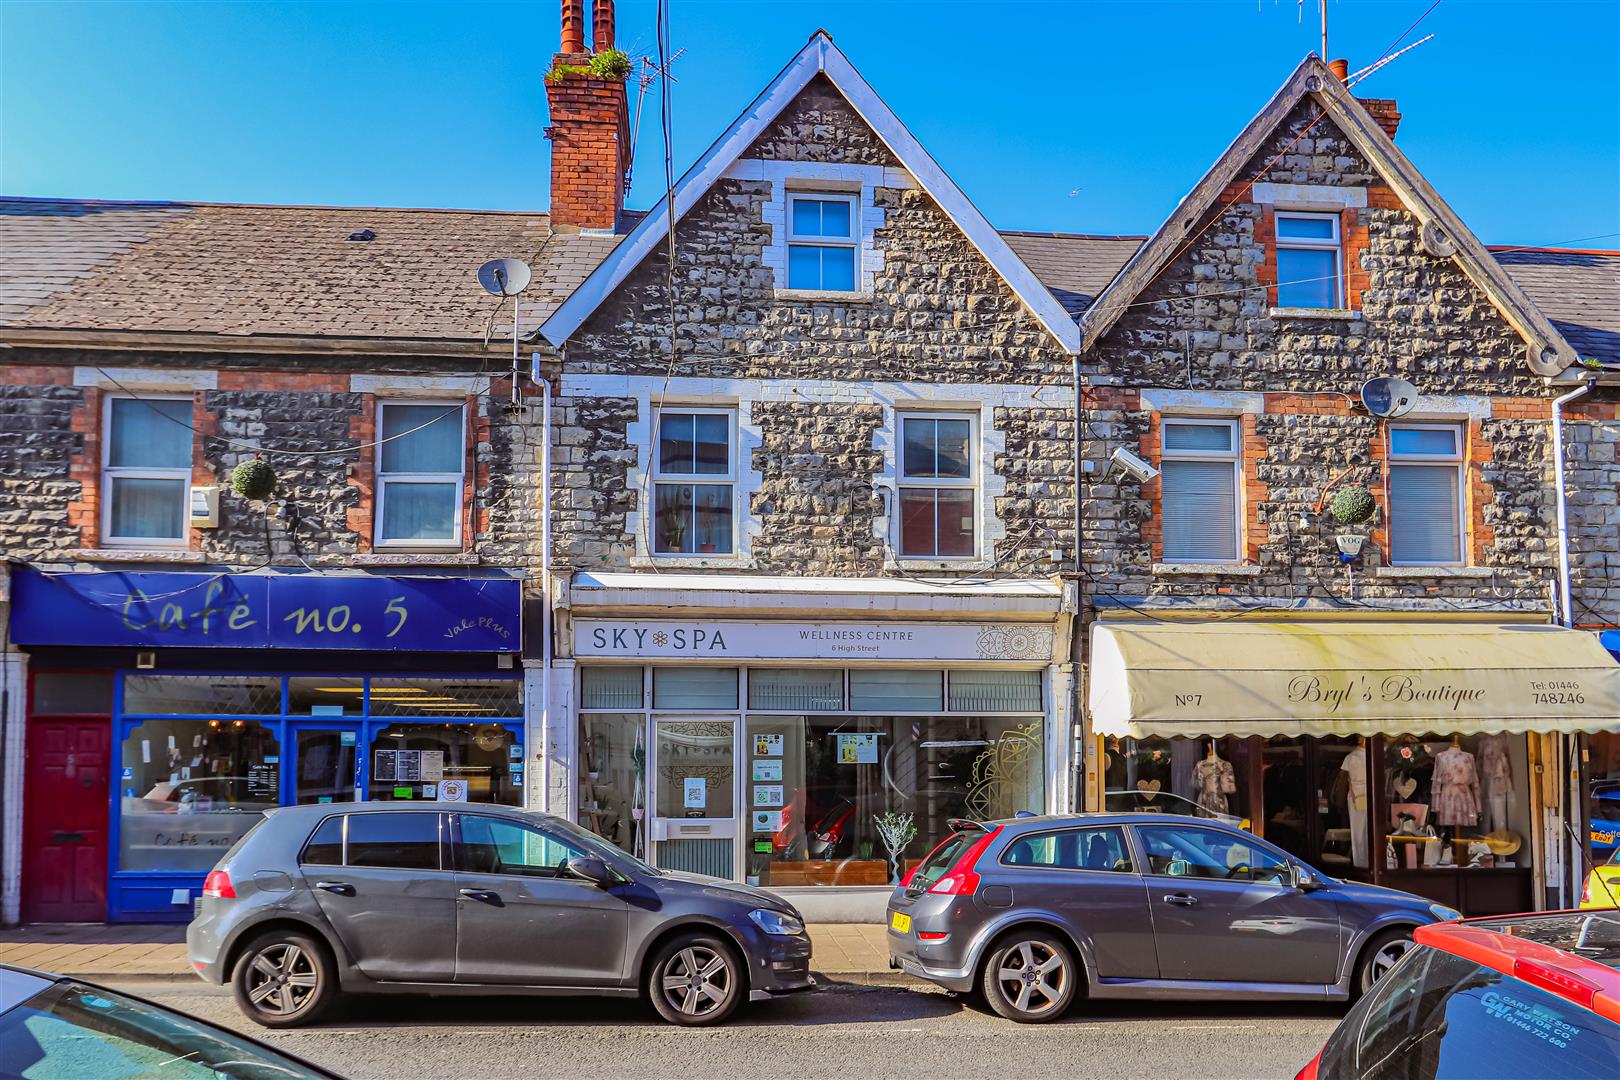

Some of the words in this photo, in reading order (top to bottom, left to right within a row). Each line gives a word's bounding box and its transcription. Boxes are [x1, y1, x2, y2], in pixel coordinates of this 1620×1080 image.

[1341, 536, 1361, 545] VOG
[122, 581, 257, 635] Café
[283, 605, 362, 634] no.
[383, 596, 409, 638] 5
[443, 619, 477, 638] Vale
[478, 616, 511, 639] Plus
[593, 627, 648, 649] SKY
[673, 628, 727, 650] SPA
[799, 630, 863, 641] WELLNESS
[866, 631, 913, 641] CENTRE
[831, 644, 837, 652] 6
[838, 644, 856, 653] High
[857, 644, 880, 652] Street
[1380, 674, 1486, 712] Boutique
[1548, 681, 1580, 690] 01446
[1531, 692, 1585, 705] 748246
[1502, 996, 1531, 1012] GARY
[1532, 1009, 1580, 1035] WATSON
[1513, 1009, 1552, 1030] MOTOR
[1553, 1028, 1572, 1041] CO.
[1531, 1027, 1549, 1040] 722
[1548, 1037, 1567, 1049] 600
